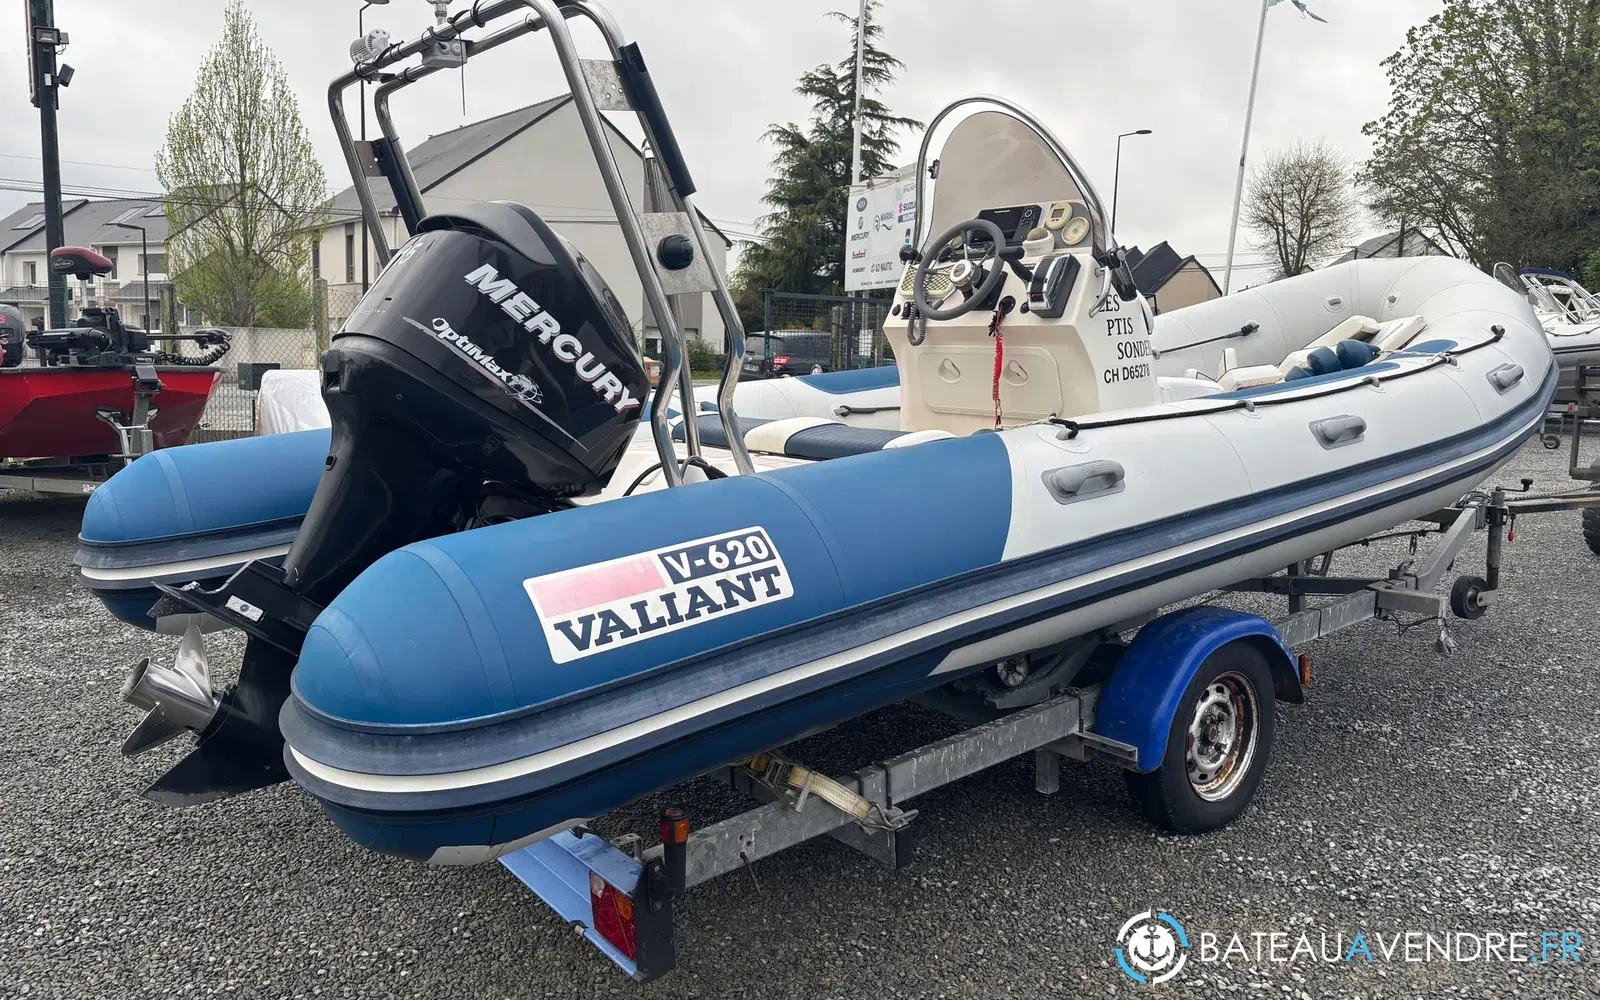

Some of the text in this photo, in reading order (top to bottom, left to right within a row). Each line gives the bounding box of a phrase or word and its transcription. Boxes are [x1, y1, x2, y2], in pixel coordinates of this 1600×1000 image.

[850, 231, 870, 241] MERCURY
[464, 263, 640, 412] MERCURY
[1106, 317, 1133, 336] PTIS
[432, 317, 513, 382] OptiMax
[1104, 363, 1150, 383] CH D65278
[664, 535, 770, 579] V-620
[553, 565, 781, 651] VALIANT
